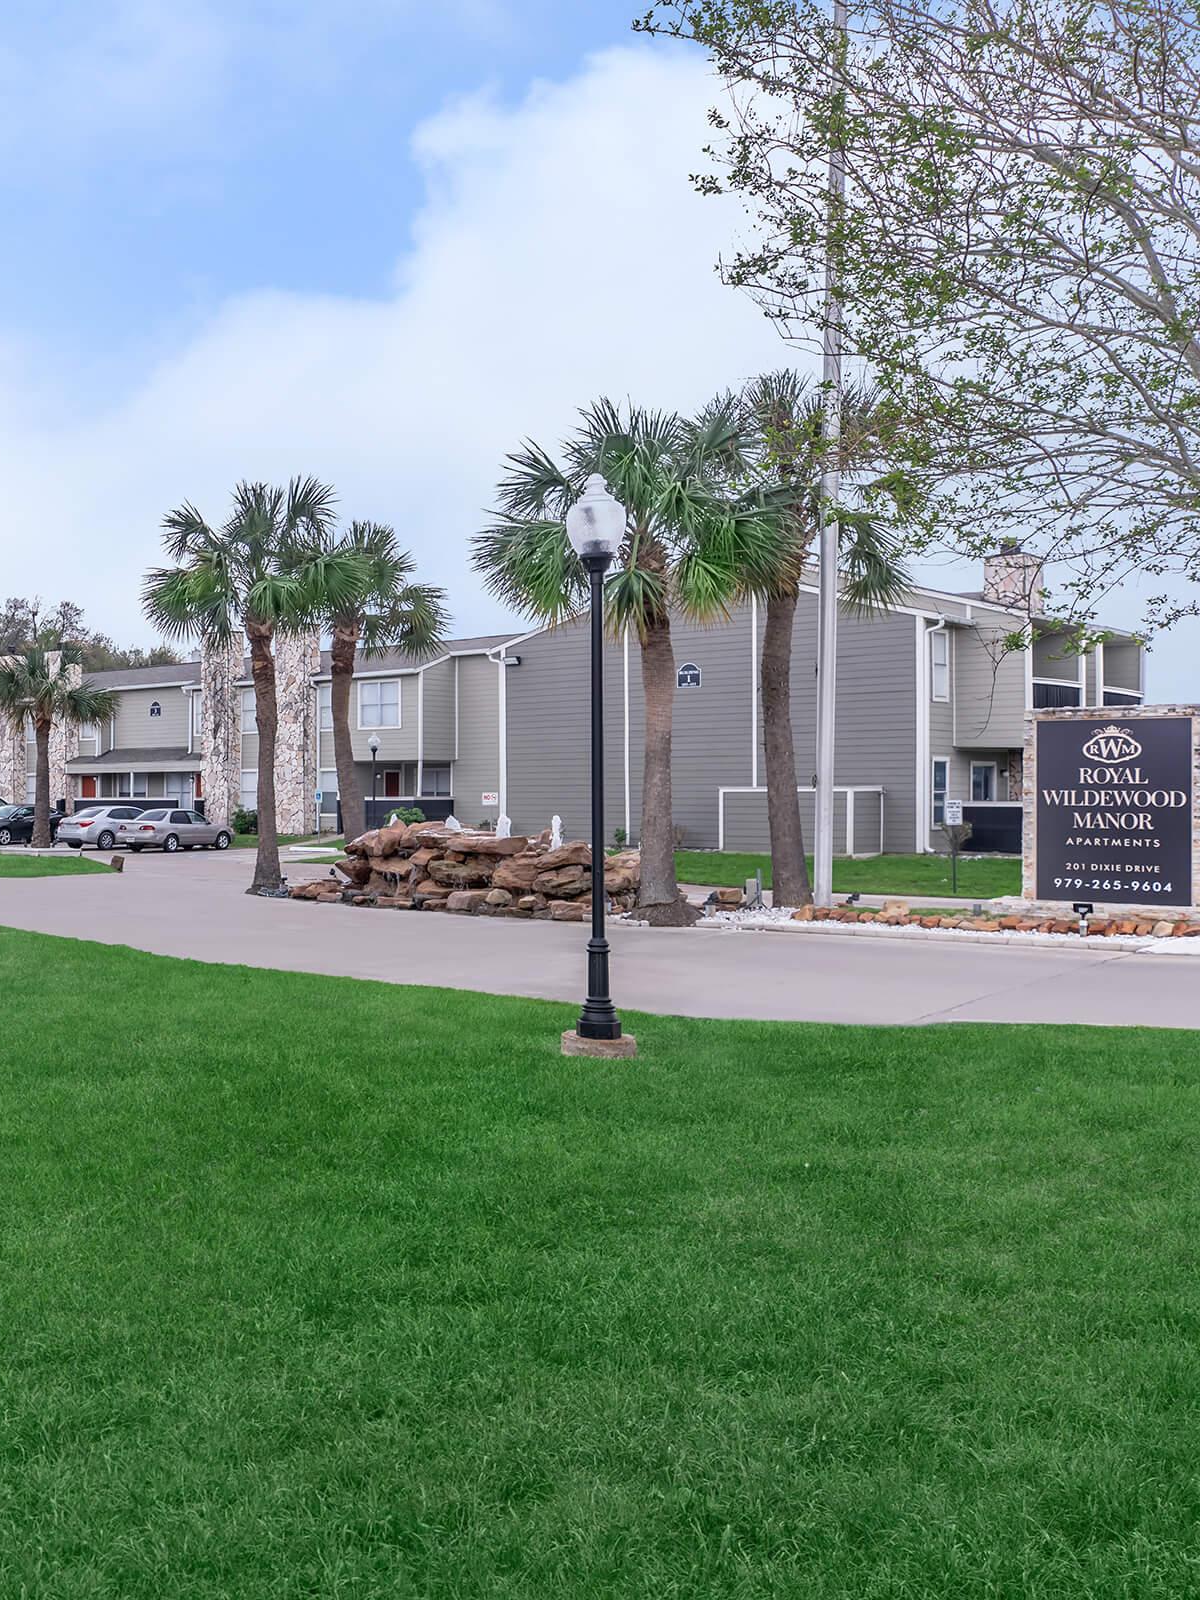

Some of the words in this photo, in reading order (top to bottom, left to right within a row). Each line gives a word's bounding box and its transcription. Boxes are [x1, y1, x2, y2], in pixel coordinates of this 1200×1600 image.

[1089, 738, 1135, 759] RWM
[1079, 767, 1149, 785] ROYAL
[1042, 789, 1187, 808] WILDEWOOD
[1073, 812, 1154, 830] MANOR
[1065, 837, 1161, 848] APARTMENTS
[1065, 862, 1086, 871] 201
[1091, 863, 1121, 872] DIXIE
[1125, 864, 1160, 873] DRIVE
[1053, 877, 1173, 893] 979-265-9604
